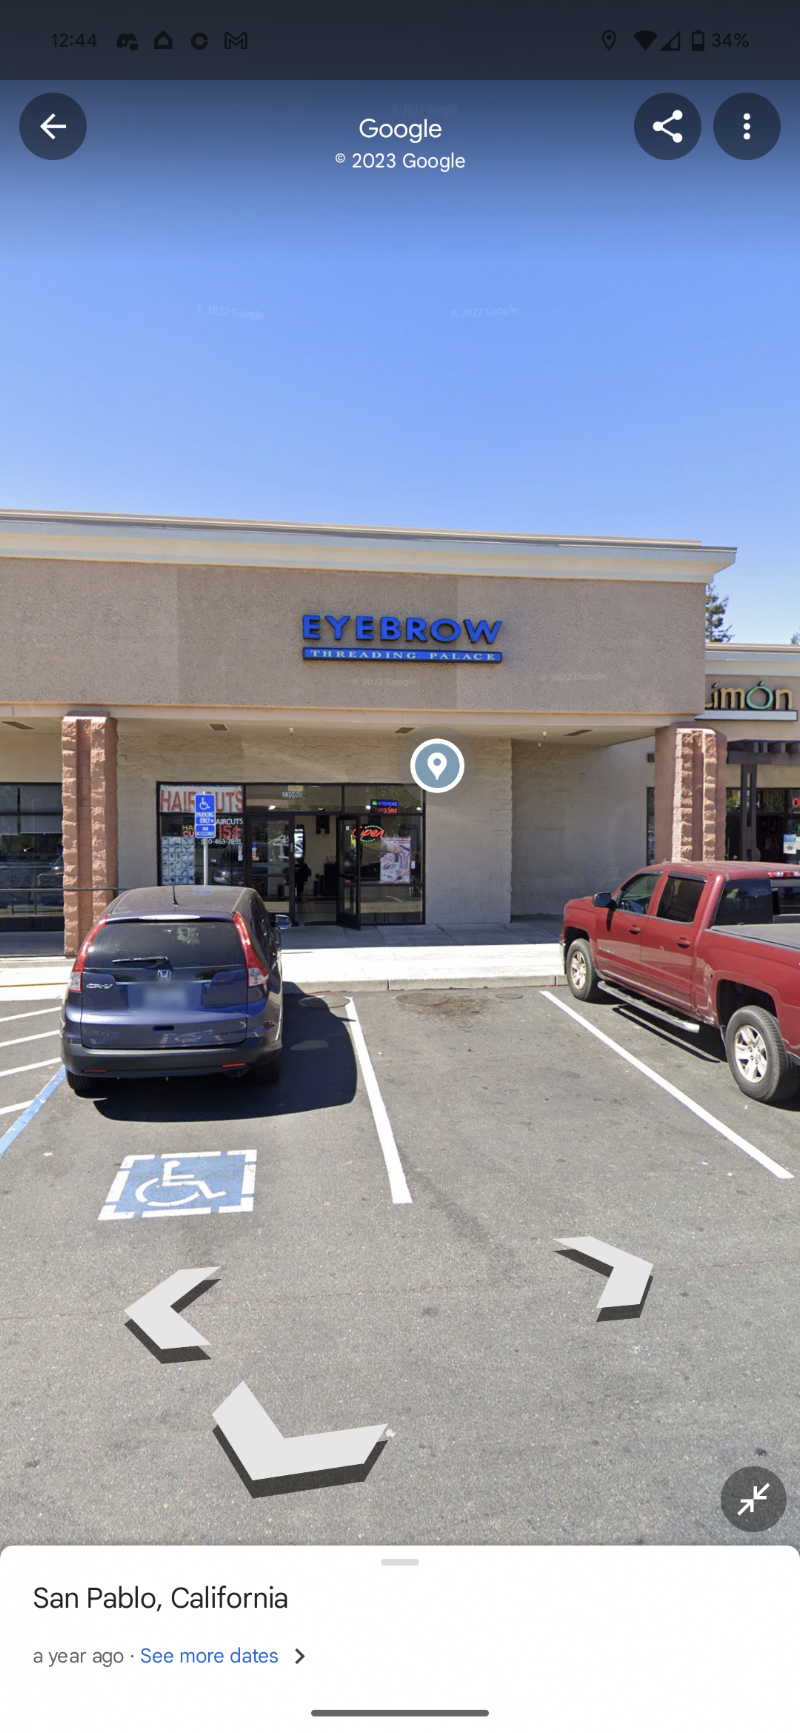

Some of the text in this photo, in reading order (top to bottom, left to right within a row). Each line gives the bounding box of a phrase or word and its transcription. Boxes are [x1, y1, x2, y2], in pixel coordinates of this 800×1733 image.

[302, 614, 503, 644] EYEBROW
[310, 650, 496, 661] THREADING PALACE
[705, 680, 793, 710] imón
[160, 789, 243, 812] HAIR UTS
[215, 817, 243, 825] AIRCUTS
[218, 825, 241, 839] 15$
